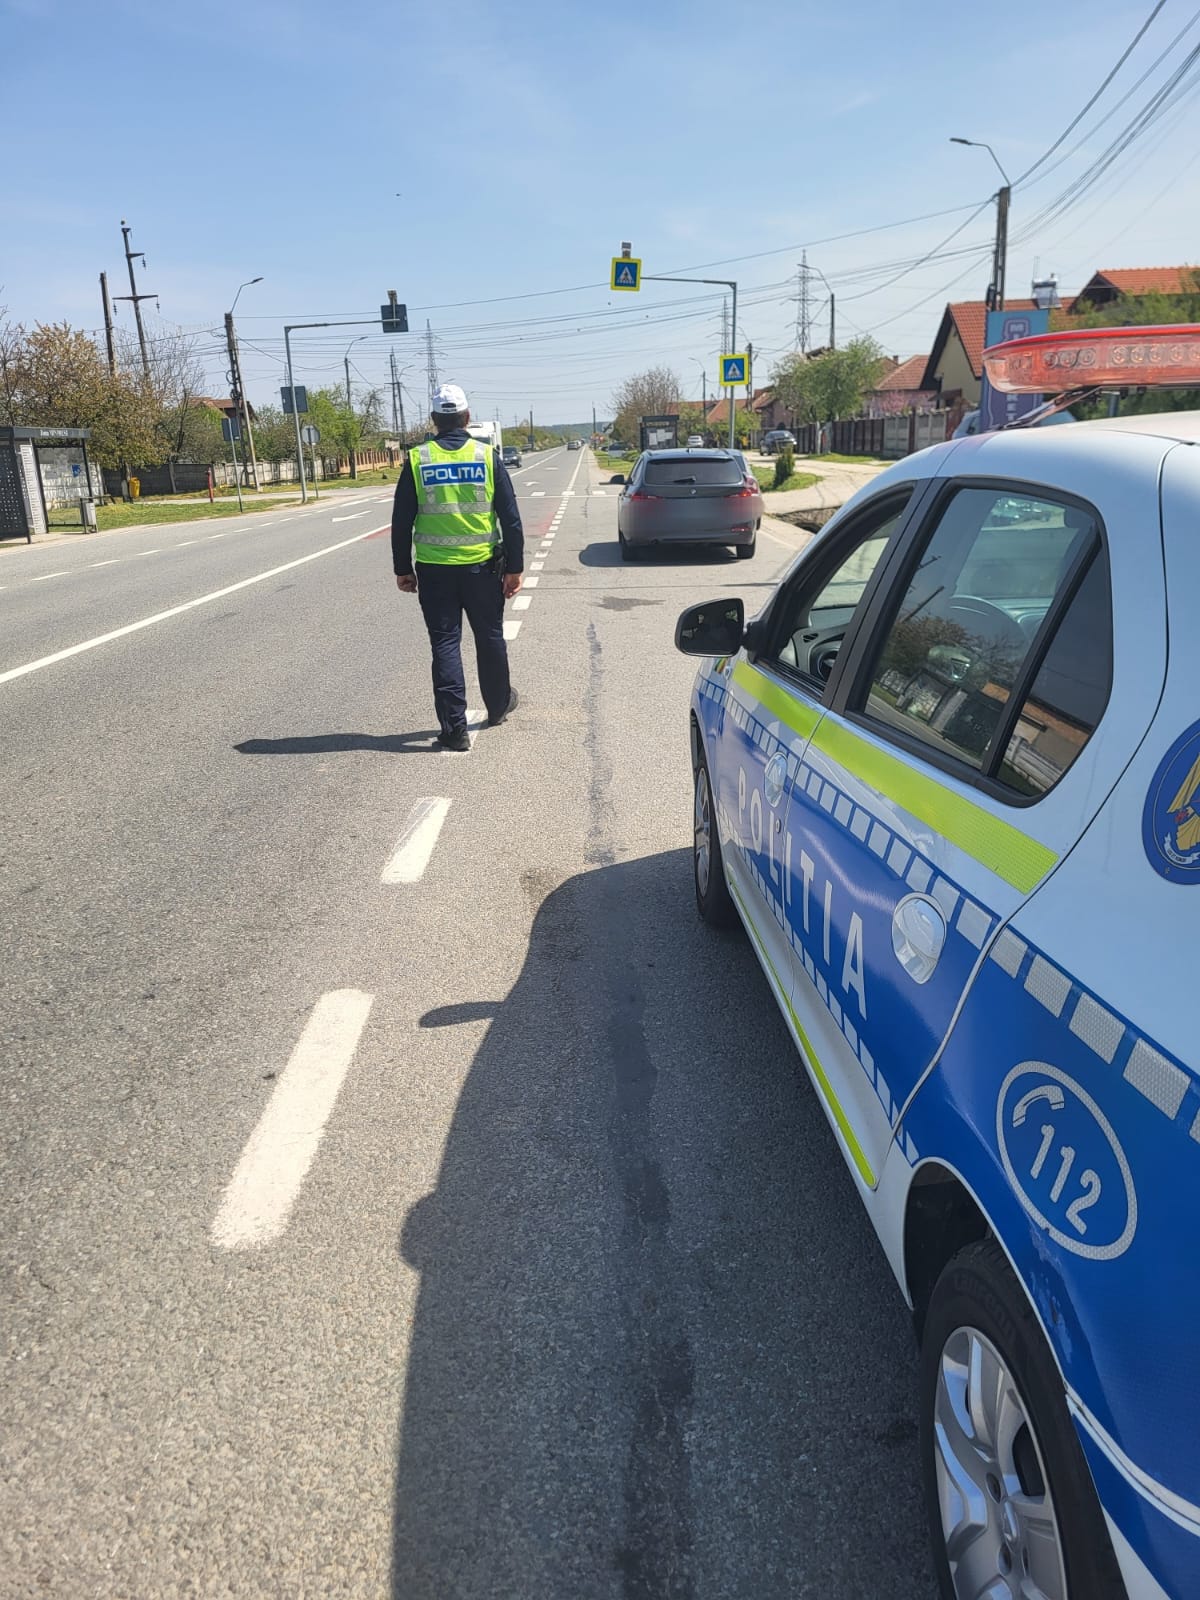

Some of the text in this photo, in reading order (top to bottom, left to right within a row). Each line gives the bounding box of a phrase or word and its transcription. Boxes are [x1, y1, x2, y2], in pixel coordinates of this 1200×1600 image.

[423, 467, 484, 482] POLITIA
[738, 766, 868, 1022] POLITIA
[1030, 1124, 1102, 1236] 112
